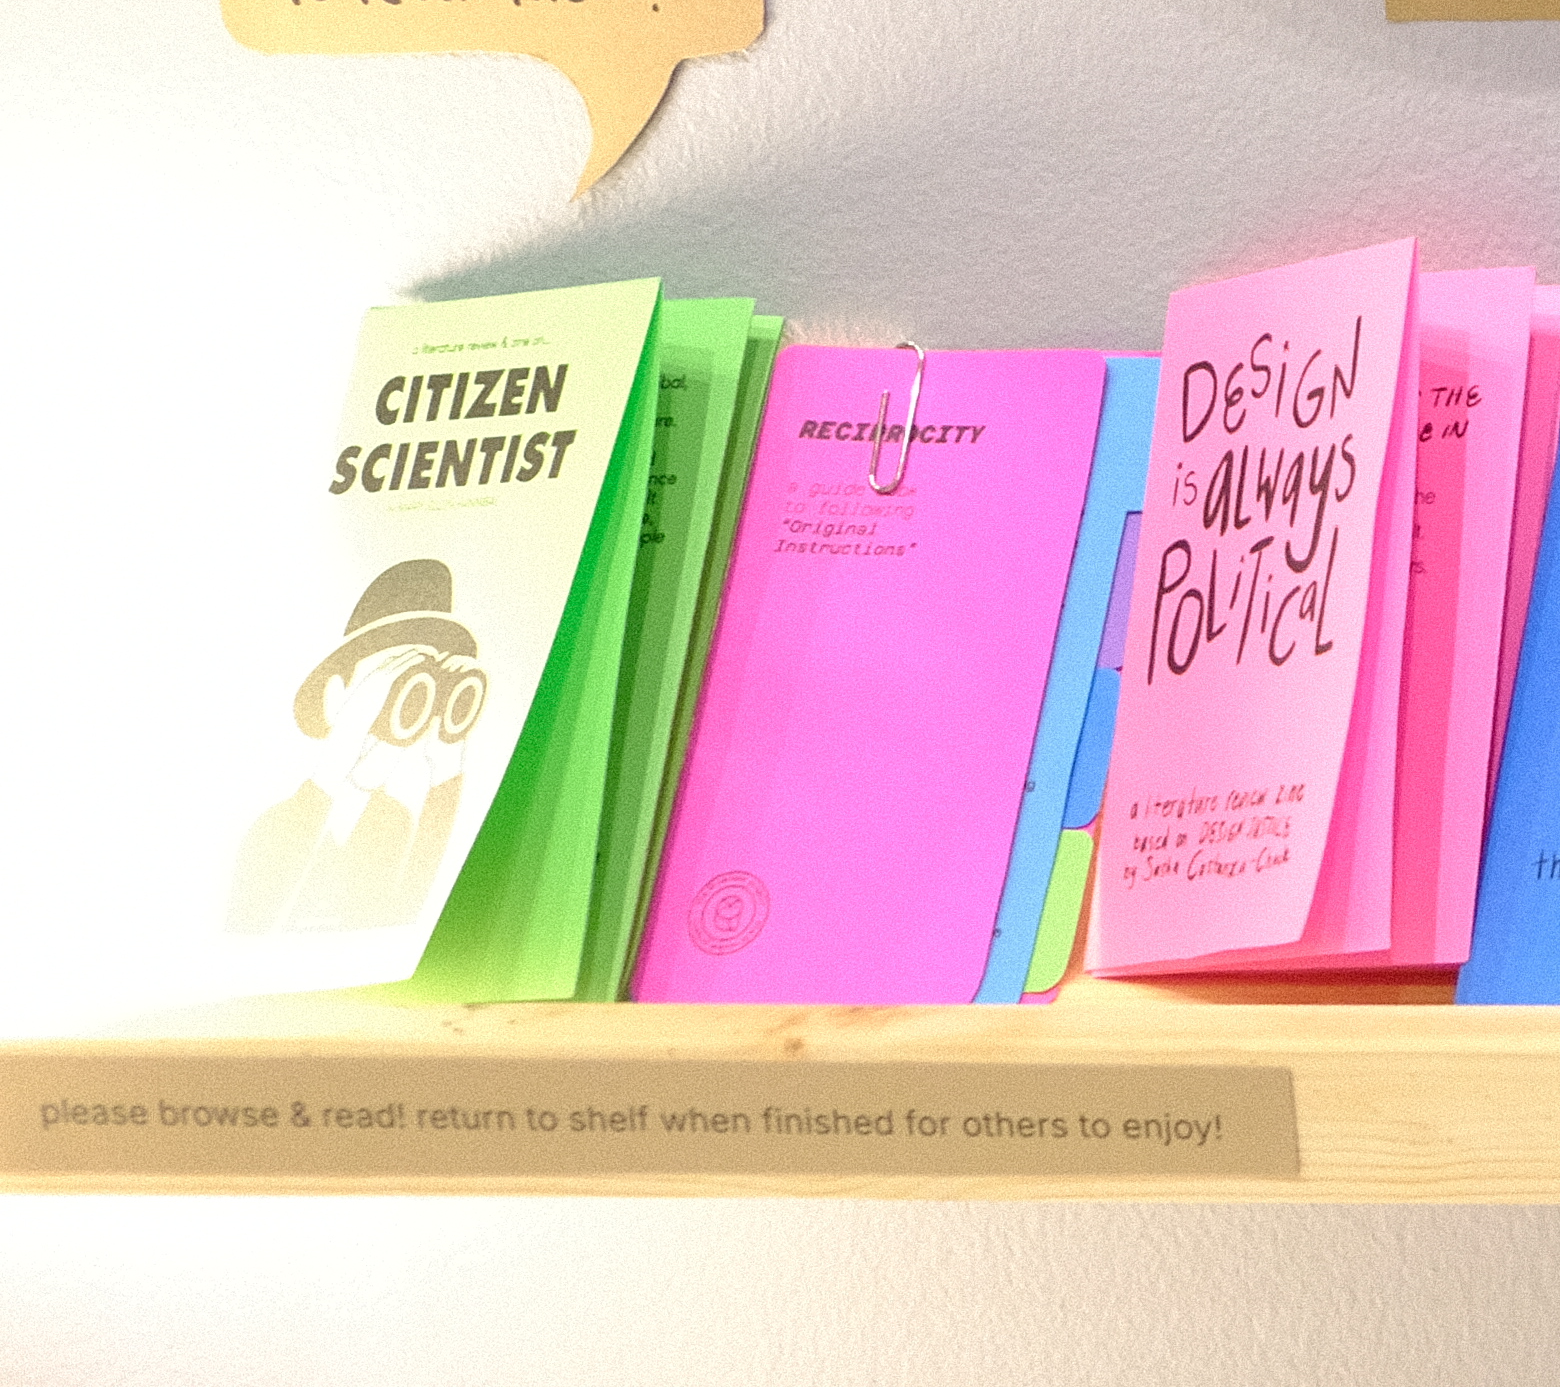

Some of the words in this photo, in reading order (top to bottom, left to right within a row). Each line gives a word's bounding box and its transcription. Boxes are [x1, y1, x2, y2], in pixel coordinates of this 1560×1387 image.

[374, 364, 568, 425] CITIZEN
[328, 430, 577, 496] SCIENTIST
[40, 1099, 149, 1127] please
[157, 1099, 279, 1127] browse
[290, 1101, 311, 1127] &
[322, 1102, 404, 1128] read!
[417, 1104, 516, 1131] return
[526, 1105, 559, 1132] to
[569, 1103, 648, 1133] shelf
[660, 1106, 750, 1134] when
[762, 1106, 895, 1137] finished
[905, 1109, 951, 1138] for
[963, 1111, 1068, 1139] others
[1079, 1113, 1110, 1139] to
[1123, 1114, 1222, 1146] enjoy!
